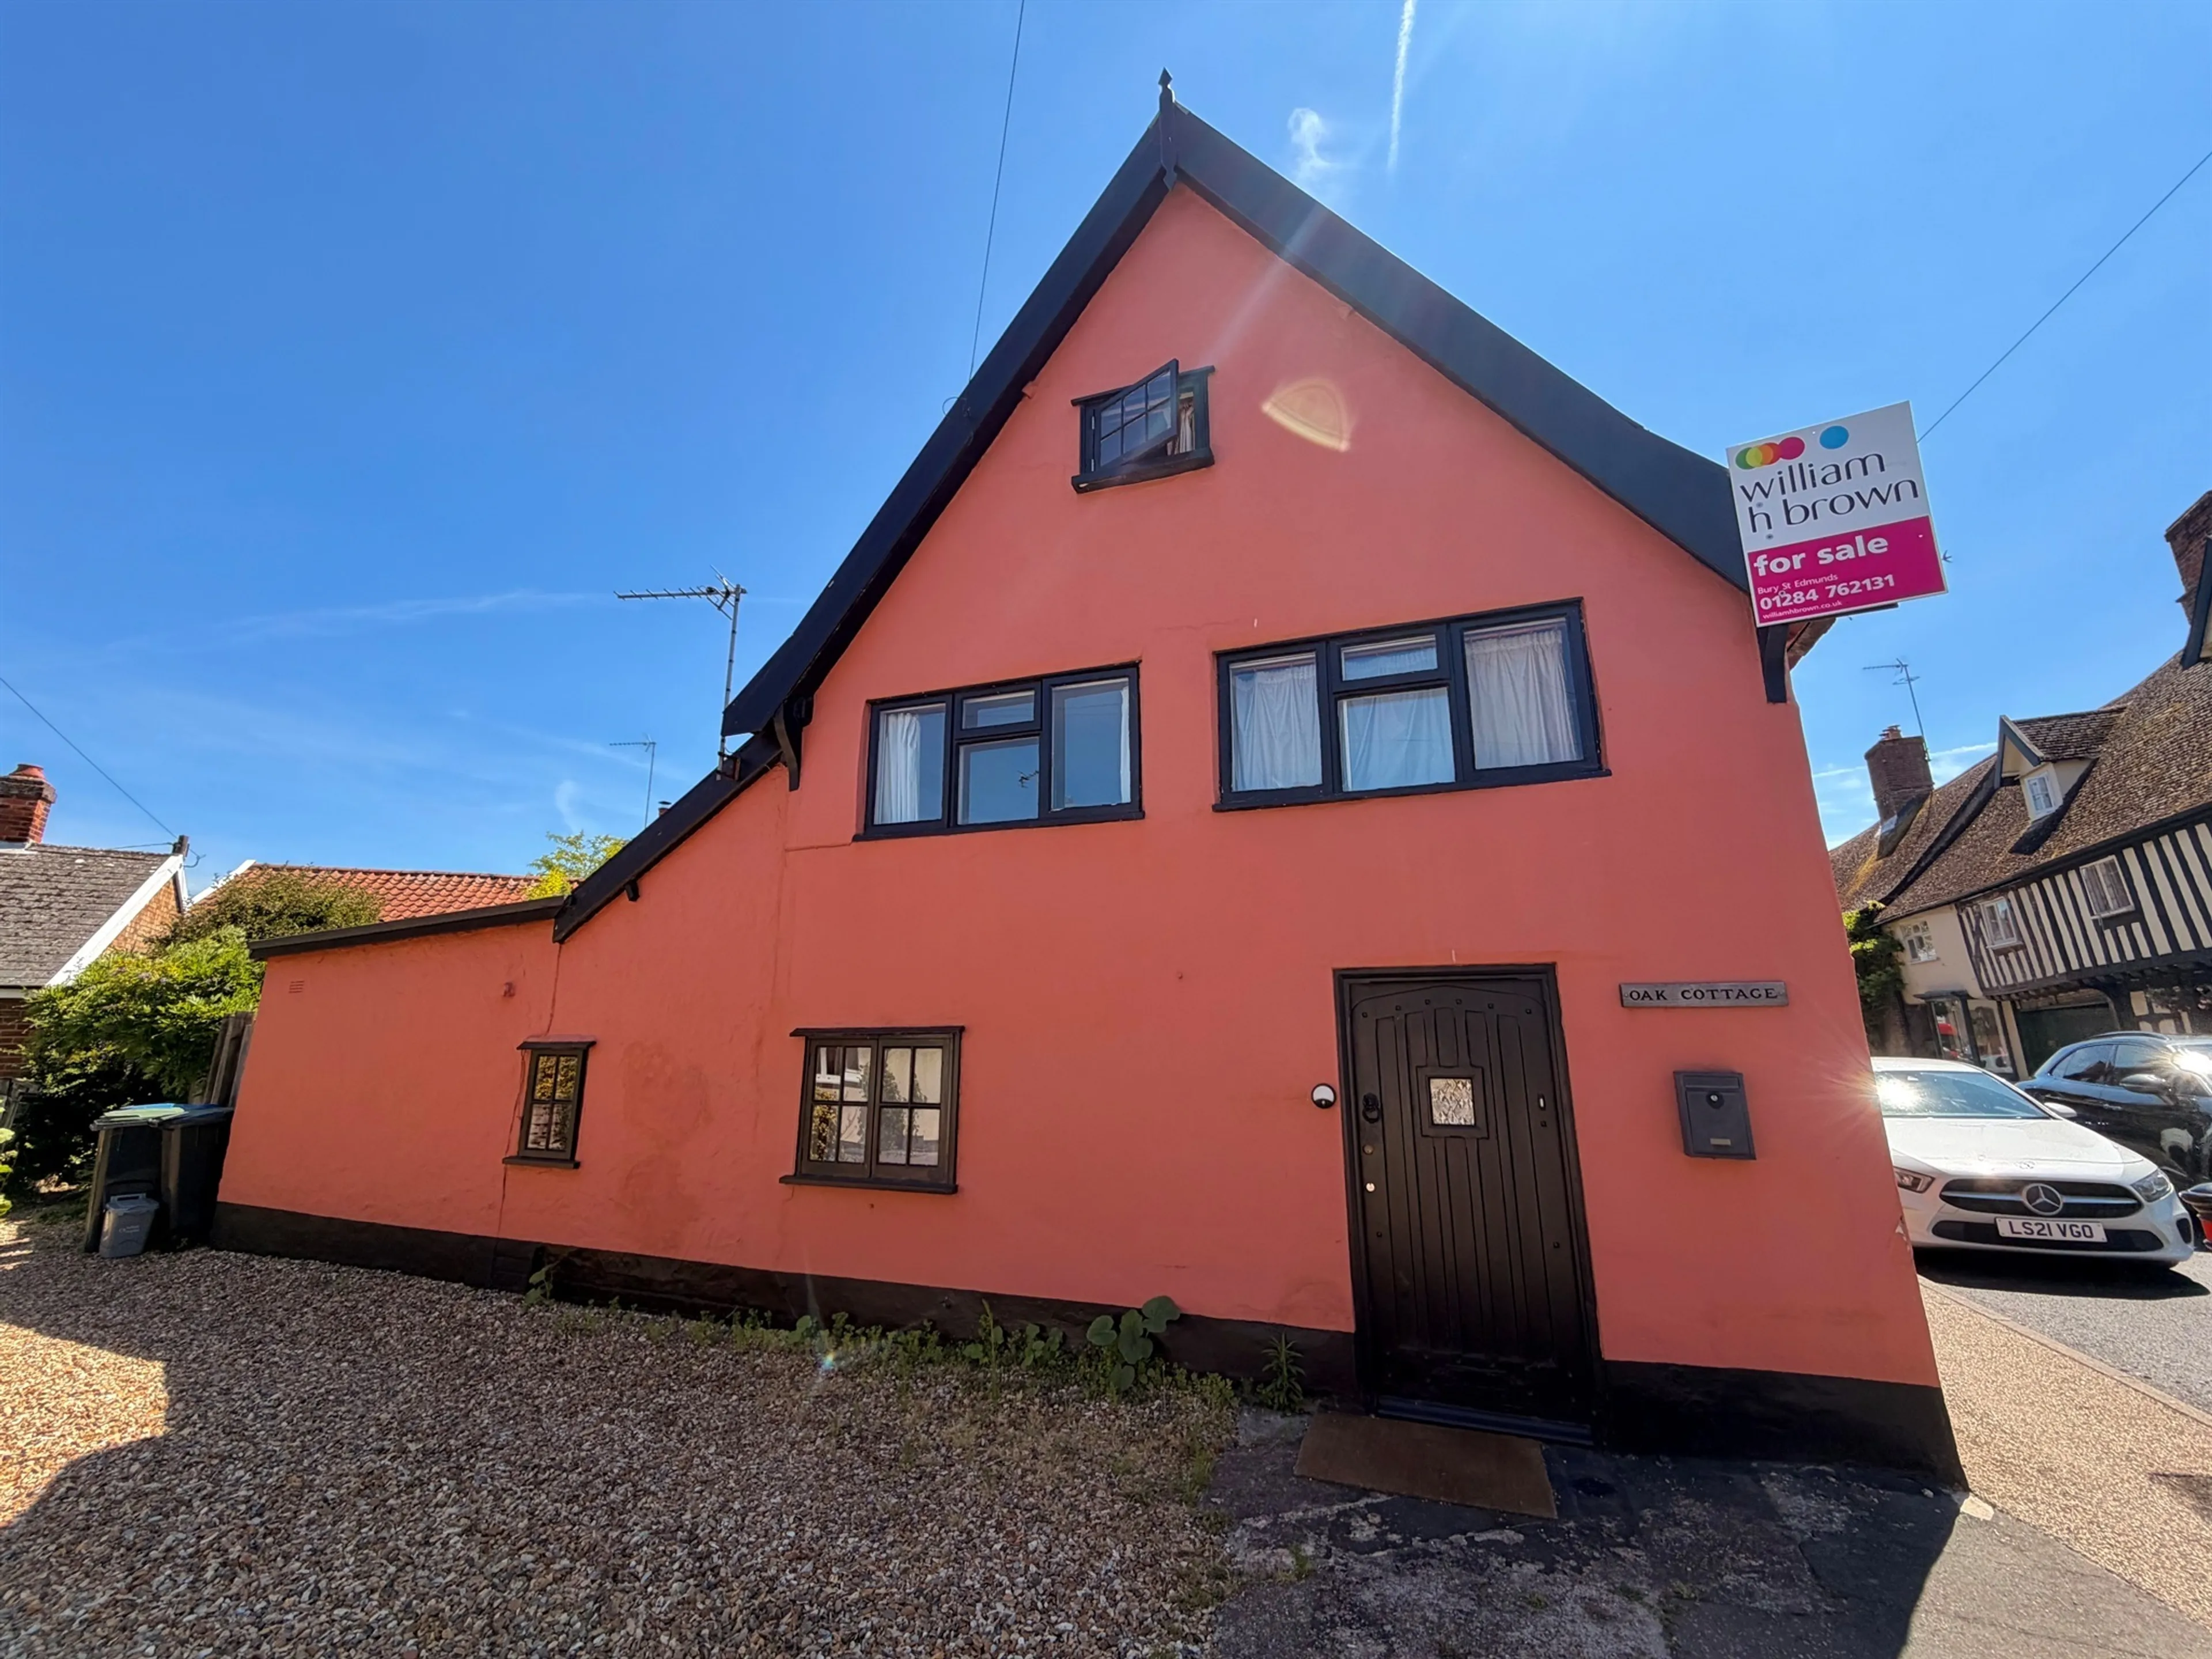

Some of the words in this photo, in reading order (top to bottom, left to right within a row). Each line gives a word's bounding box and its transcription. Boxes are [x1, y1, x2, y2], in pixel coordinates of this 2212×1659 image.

[1740, 453, 1885, 502] william
[1748, 506, 1772, 533] h
[1782, 479, 1919, 525] brown
[1753, 552, 1806, 577] for
[1817, 535, 1888, 565] sale
[1758, 584, 1779, 595] Bury
[1782, 582, 1791, 590] St
[1794, 573, 1839, 588] Edmunds
[1760, 589, 1819, 610] 01284
[1825, 574, 1895, 598] 762131
[1763, 600, 1843, 619] williamhbrown.co.uk
[1629, 990, 1668, 1001] OAK
[1680, 988, 1778, 1000] COTTAGE
[2009, 1221, 2053, 1237] LS21
[2056, 1223, 2094, 1238] VGO
